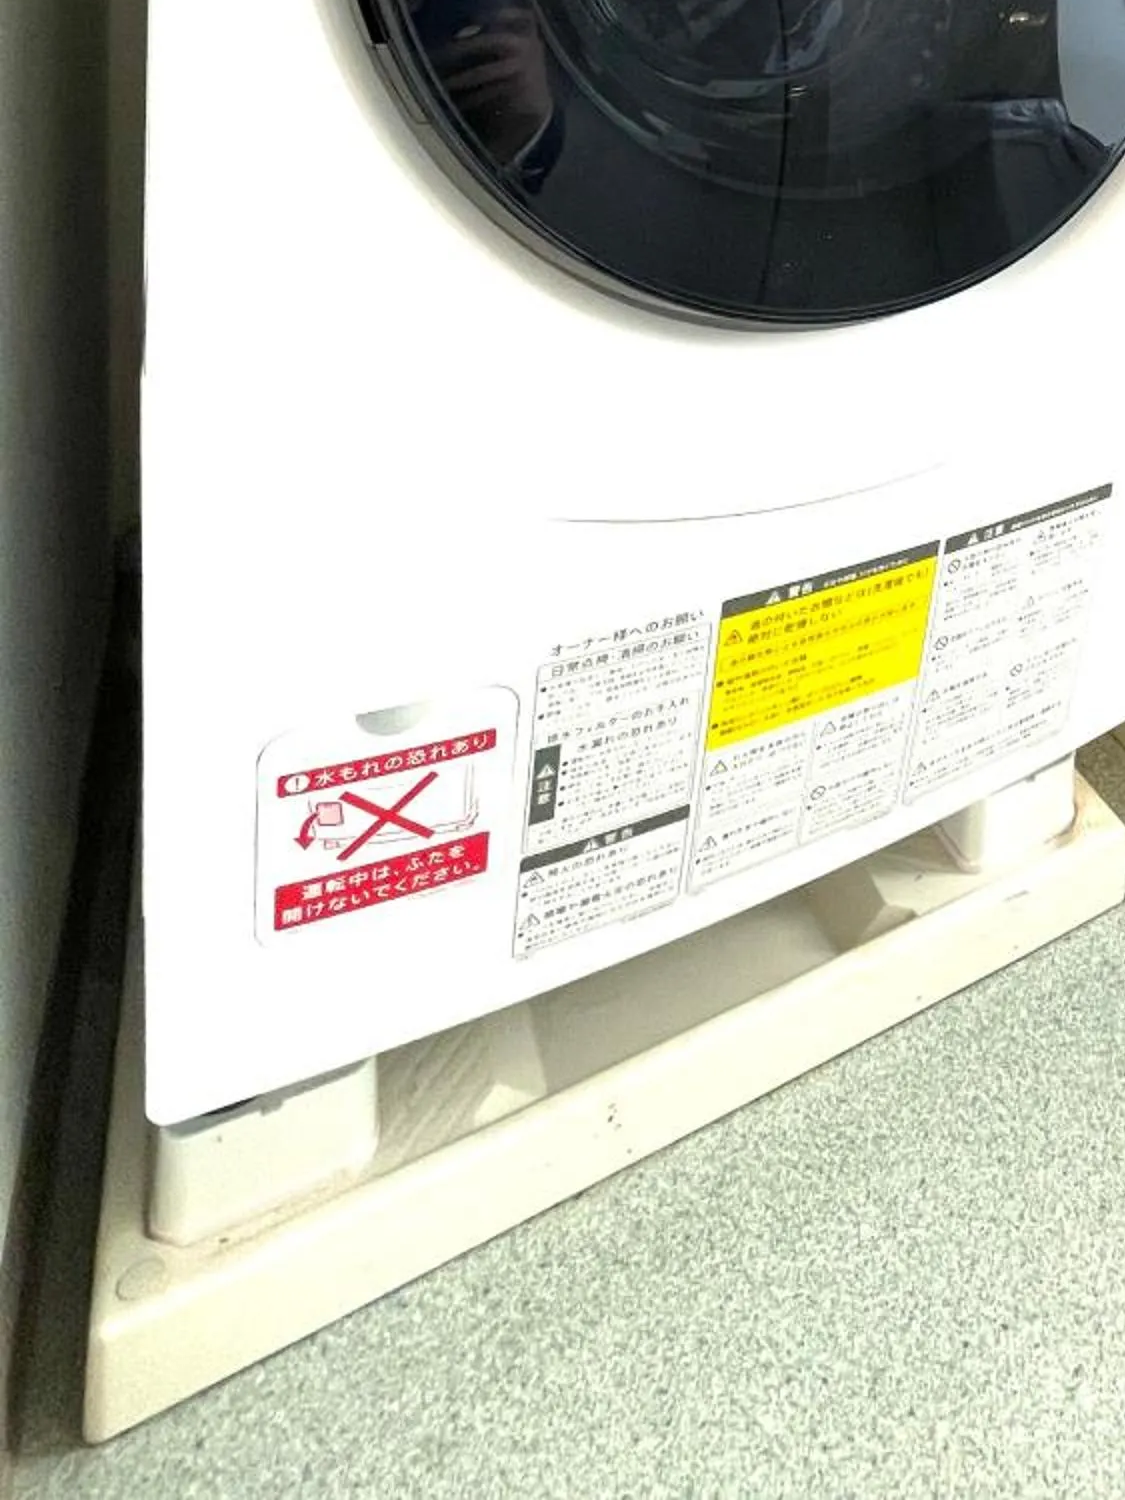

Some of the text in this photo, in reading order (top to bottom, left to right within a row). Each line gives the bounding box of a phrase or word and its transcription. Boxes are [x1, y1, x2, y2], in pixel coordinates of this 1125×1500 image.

[314, 732, 489, 789] 水もれの恐れあり
[280, 861, 482, 926] 開けないでください。
[301, 844, 466, 900] 運転中は、ふたを
